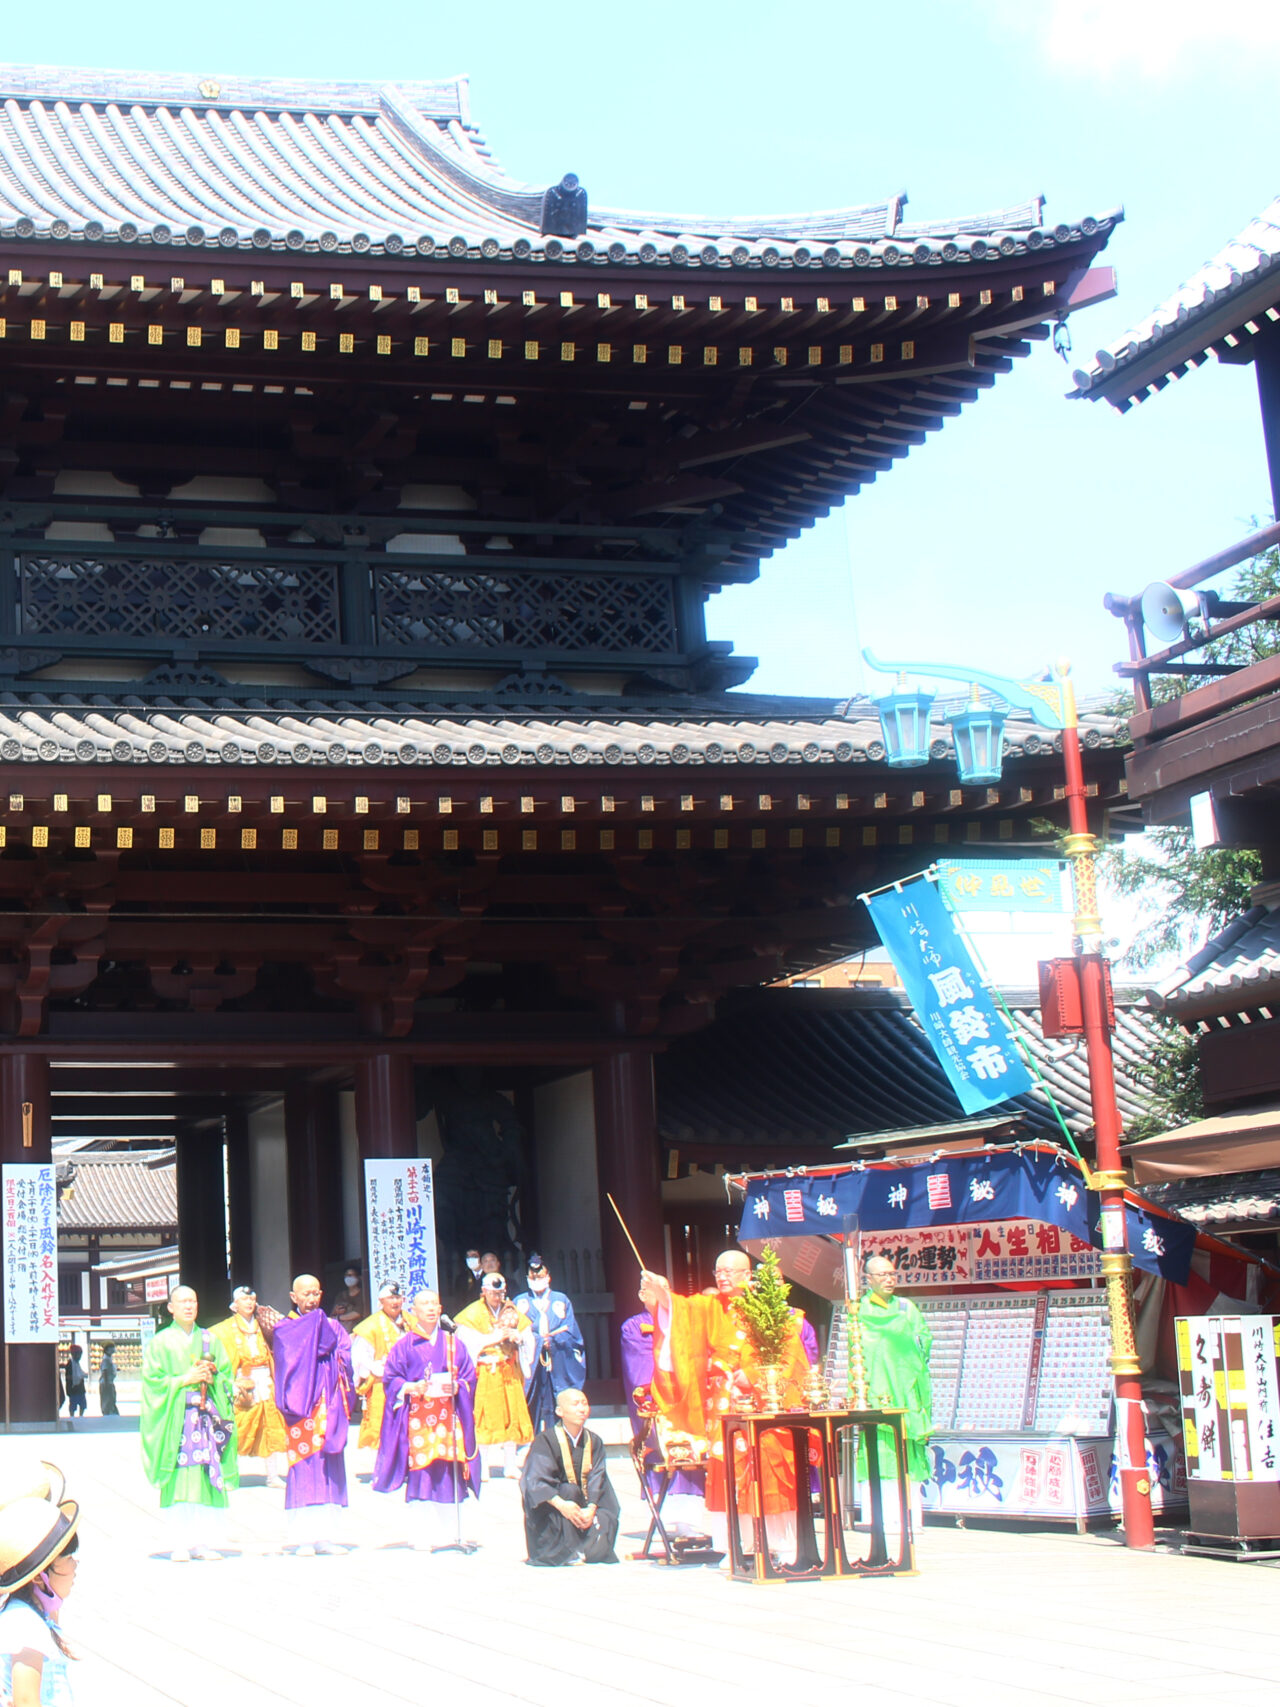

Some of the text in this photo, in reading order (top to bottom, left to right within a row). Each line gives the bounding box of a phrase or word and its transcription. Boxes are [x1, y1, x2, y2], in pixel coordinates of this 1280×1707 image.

[955, 873, 1045, 897] 仲見世
[927, 966, 1008, 1081] 風鈴市
[405, 1204, 429, 1311] 川崎大師風鈴
[753, 1176, 1166, 1257] 神 秘 神 秘 神 秘
